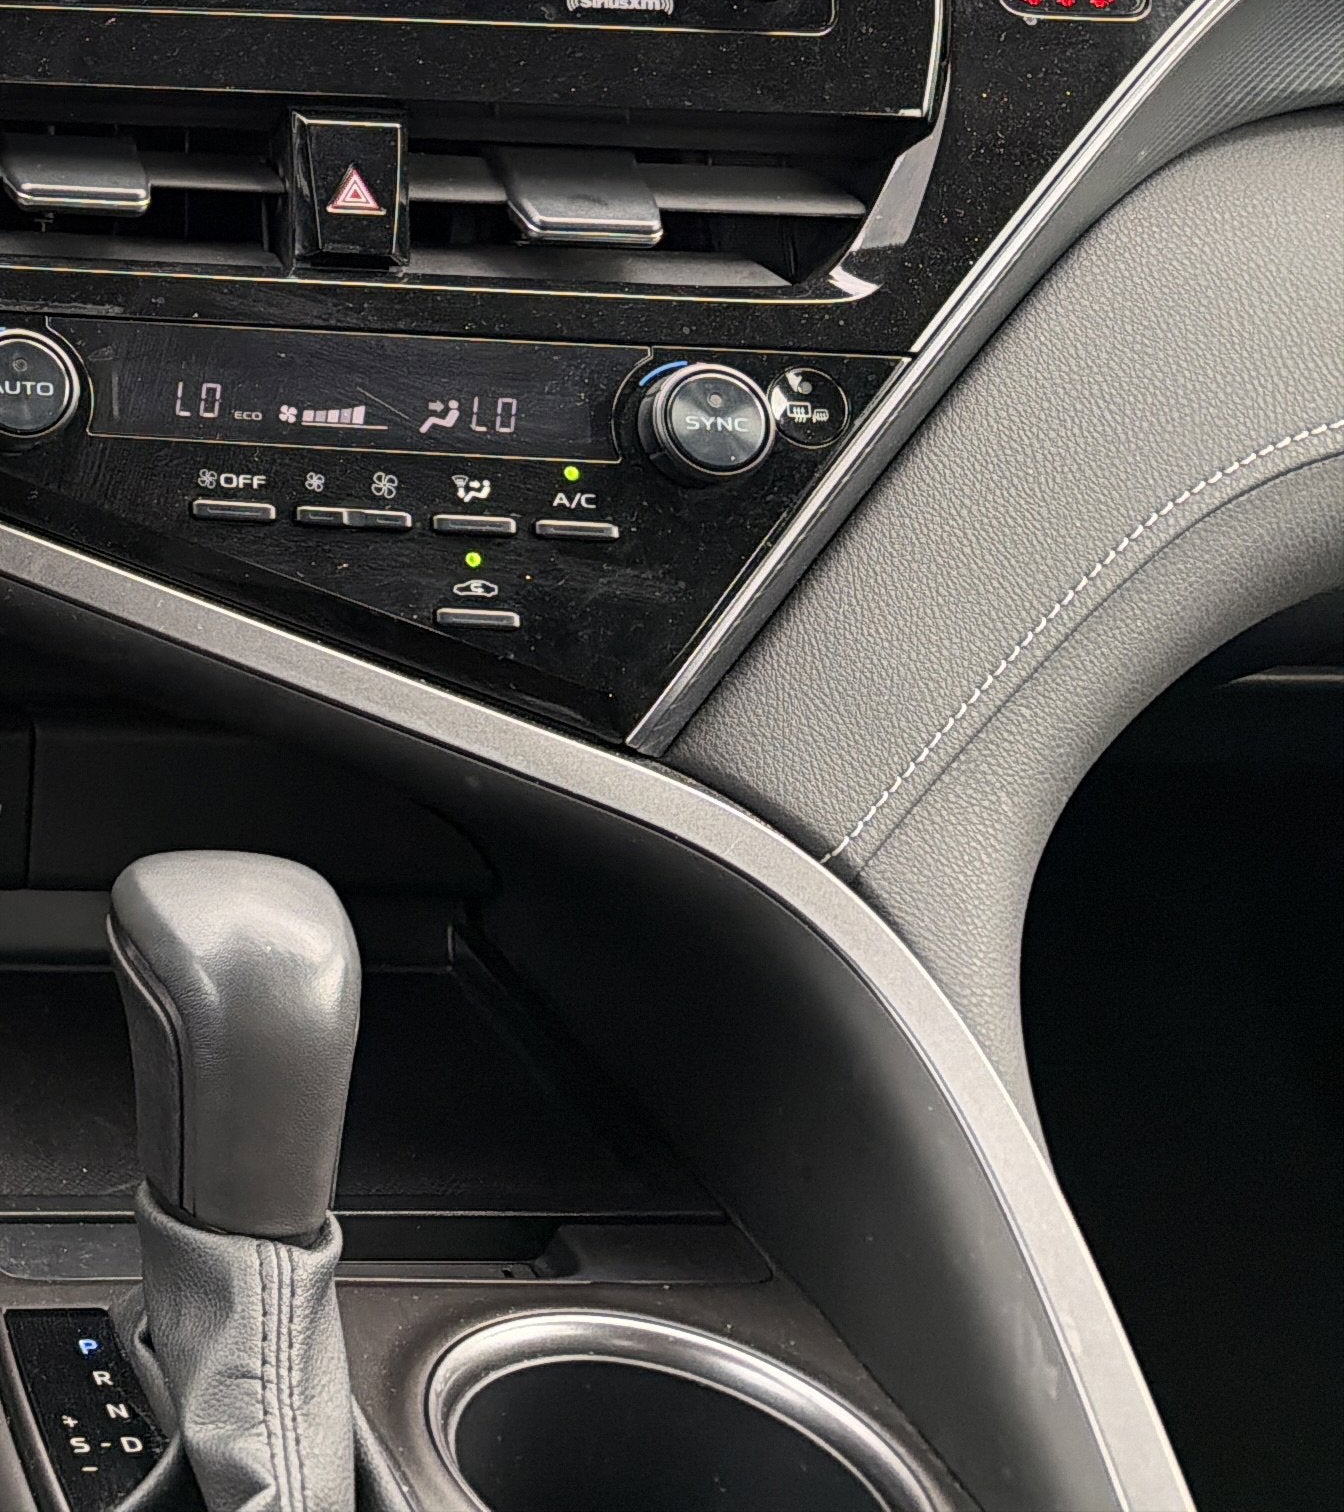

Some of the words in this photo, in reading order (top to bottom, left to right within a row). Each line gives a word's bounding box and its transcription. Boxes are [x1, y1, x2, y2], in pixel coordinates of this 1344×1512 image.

[175, 381, 221, 418] LO
[233, 410, 263, 421] ECO
[469, 396, 517, 433] LO
[685, 416, 749, 433] SYNC
[219, 473, 267, 489] OFF
[552, 492, 597, 509] A/C
[79, 1339, 98, 1354] P
[93, 1371, 113, 1386] R
[106, 1403, 129, 1419] N
[70, 1437, 90, 1452] S
[121, 1437, 143, 1453] D
